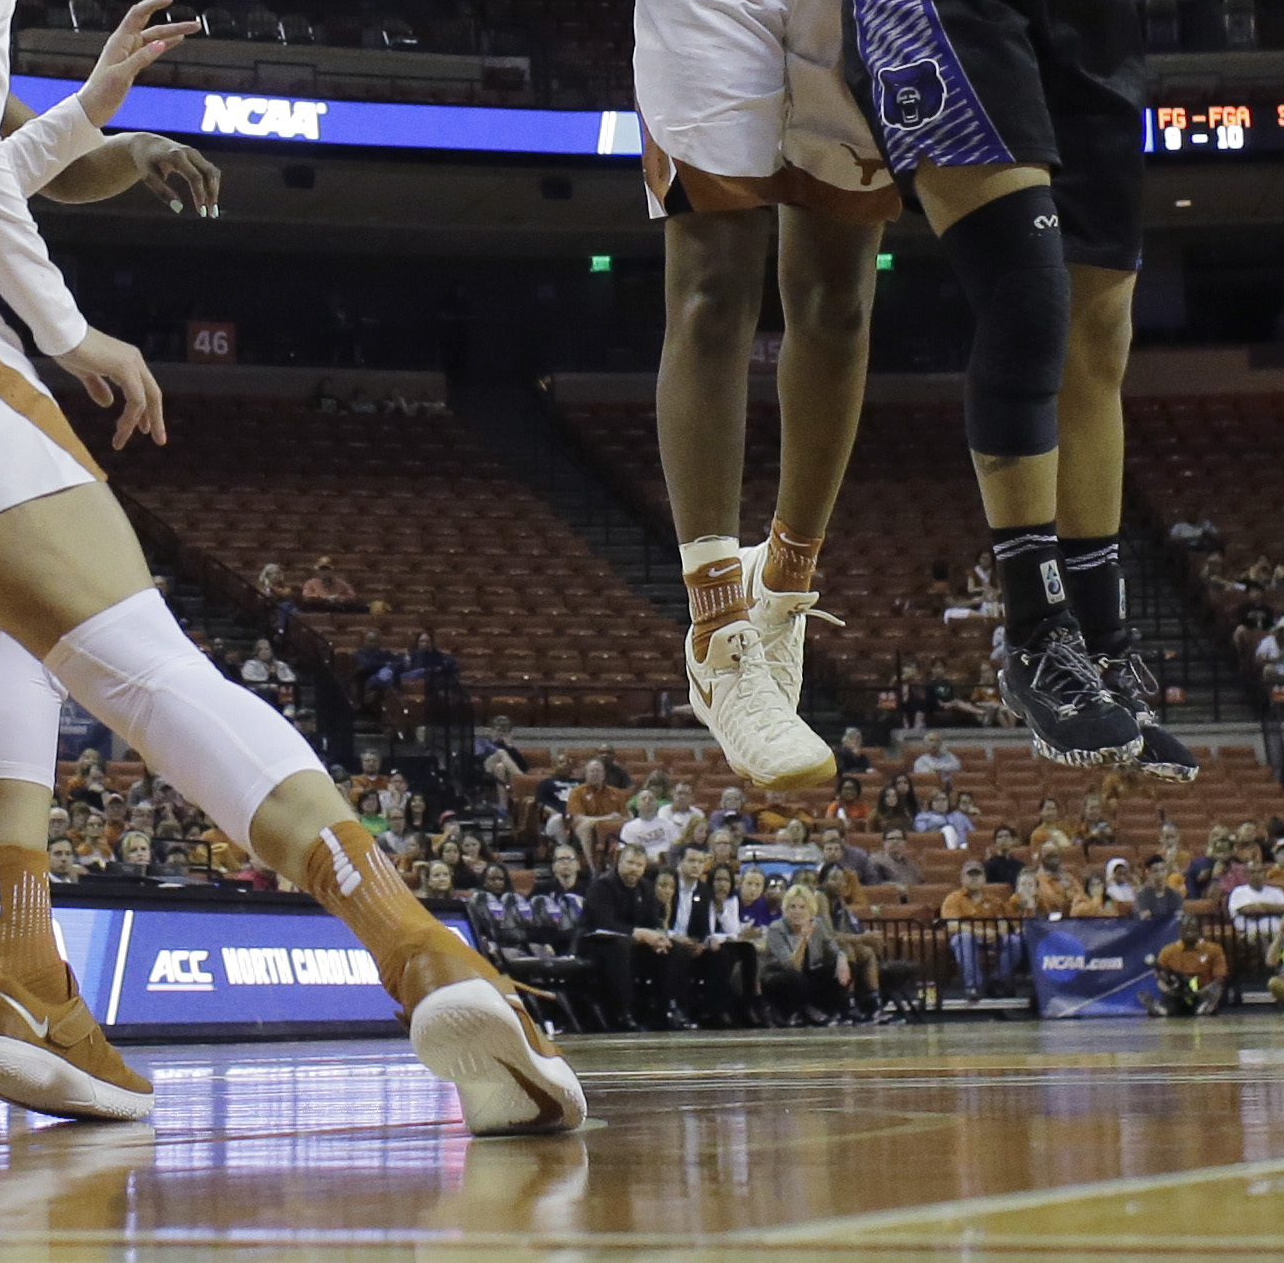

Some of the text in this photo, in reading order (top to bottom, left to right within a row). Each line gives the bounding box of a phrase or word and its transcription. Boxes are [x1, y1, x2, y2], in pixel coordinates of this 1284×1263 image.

[201, 95, 325, 139] NCAA
[194, 330, 229, 356] 46
[149, 949, 214, 983] ACC
[221, 947, 295, 985] NORTH
[1042, 955, 1124, 971] NCAA.com
